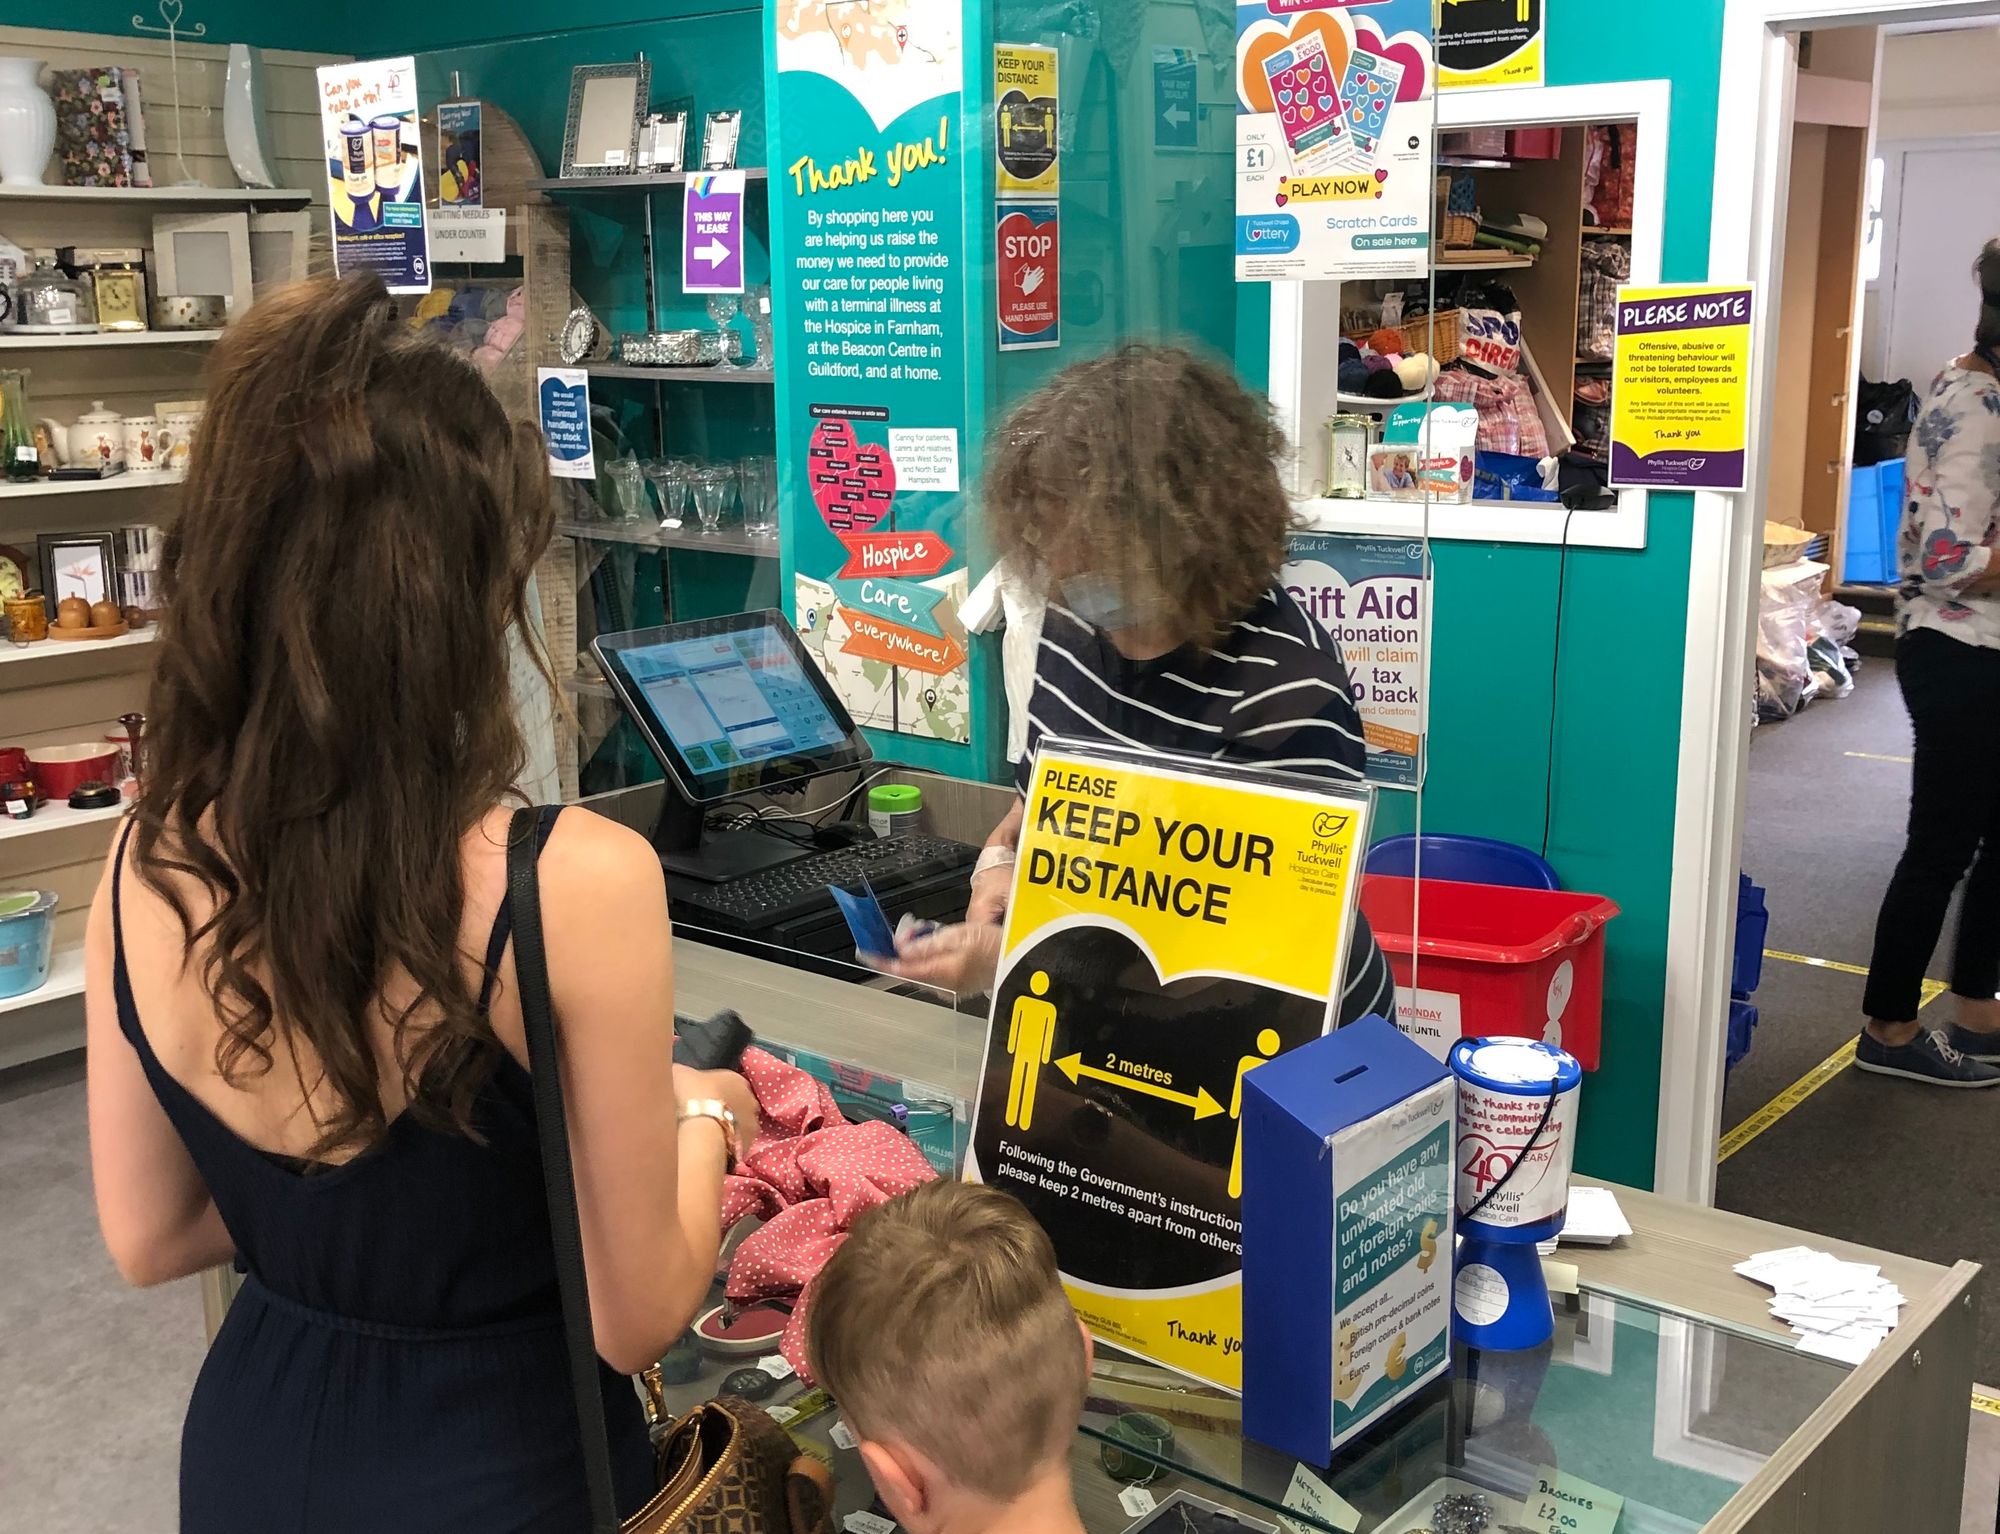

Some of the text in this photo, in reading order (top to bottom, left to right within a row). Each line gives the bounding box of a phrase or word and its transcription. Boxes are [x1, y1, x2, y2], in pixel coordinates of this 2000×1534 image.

[1297, 42, 1321, 60] £1000
[998, 58, 1020, 69] KEEP
[1021, 59, 1045, 72] YOUR
[998, 72, 1039, 85] DISTANCE
[788, 115, 948, 196] Thank you!
[1246, 147, 1265, 168] £1
[1291, 180, 1370, 197] PLAY NOW
[433, 209, 490, 219] KNITTING NEEDLES
[693, 212, 732, 222] THIS WAY
[807, 208, 933, 228] By shopping here you
[1326, 214, 1418, 230] Scratch Cards
[435, 229, 486, 239] UNDER COUNTER
[697, 223, 729, 234] PLEASE
[1005, 235, 1052, 259] STOP
[1355, 235, 1418, 247] On sale here
[796, 253, 949, 272] money we need to provide
[802, 275, 944, 294] our care for people living
[1012, 301, 1048, 311] PLEASE USE
[1623, 297, 1746, 327] PLEASE NOTE
[1005, 312, 1054, 323] HAND SANITISER
[804, 319, 944, 338] the Hospice in Farnham,
[1467, 312, 1520, 346] SPO
[807, 340, 942, 358] at the Beacon Centre in
[1639, 342, 1680, 351] Offensive,
[1682, 342, 1714, 350] abusive
[1628, 354, 1675, 363] threatening
[1677, 353, 1719, 361] behaviour
[808, 361, 942, 381] Guildford, and at home.
[1630, 365, 1644, 373] not
[1640, 376, 1672, 384] visitors,
[1674, 376, 1719, 385] employees
[1721, 376, 1738, 384] and
[1657, 387, 1702, 395] volunteers.
[895, 433, 951, 443] Caring for patients,
[1654, 429, 1701, 440] Thank you
[862, 540, 928, 571] Hospice
[860, 579, 918, 623] Care,
[1284, 585, 1418, 620] Gift Aid
[853, 618, 950, 665] everywhere!
[1330, 624, 1418, 643] donation
[1345, 646, 1418, 663] will claim
[1372, 666, 1403, 684] tax
[1372, 685, 1418, 704] back
[1043, 768, 1118, 801] PLEASE
[1036, 795, 1275, 878] KEEP YOUR
[1311, 840, 1344, 856] Phyllis
[1297, 850, 1342, 869] Tuckwell
[1027, 847, 1232, 926] DISTANCE
[1398, 1006, 1442, 1020] MONDAY
[1414, 1025, 1442, 1038] UNTIL
[1105, 1052, 1173, 1085] 2 metres
[1482, 1097, 1523, 1111] thanks
[1526, 1099, 1540, 1111] to
[1543, 1098, 1562, 1111] or
[1462, 1145, 1514, 1193] 40
[998, 1139, 1056, 1173] Following
[1057, 1160, 1078, 1178] the
[1079, 1167, 1168, 1209] Government's
[1169, 1196, 1243, 1234] instruction
[1339, 1139, 1440, 1223] Do you have any
[997, 1161, 1037, 1185] please
[1038, 1172, 1070, 1198] keep
[1070, 1185, 1080, 1200] 2
[1081, 1189, 1125, 1216] metres
[1127, 1206, 1162, 1229] apart
[1164, 1216, 1197, 1240] from
[1340, 1171, 1426, 1247] unwanted old
[1341, 1187, 1438, 1271] or foreign coins
[1341, 1227, 1413, 1295] and notes?
[1349, 1320, 1374, 1344] British
[1374, 1293, 1416, 1331] pre-decimal
[1416, 1281, 1436, 1300] coins
[1166, 1319, 1218, 1347] Thank
[1221, 1335, 1243, 1357] yo
[1349, 1360, 1371, 1382] Euros
[1295, 1475, 1323, 1505] METRIC
[1538, 1479, 1594, 1511] BROCHES
